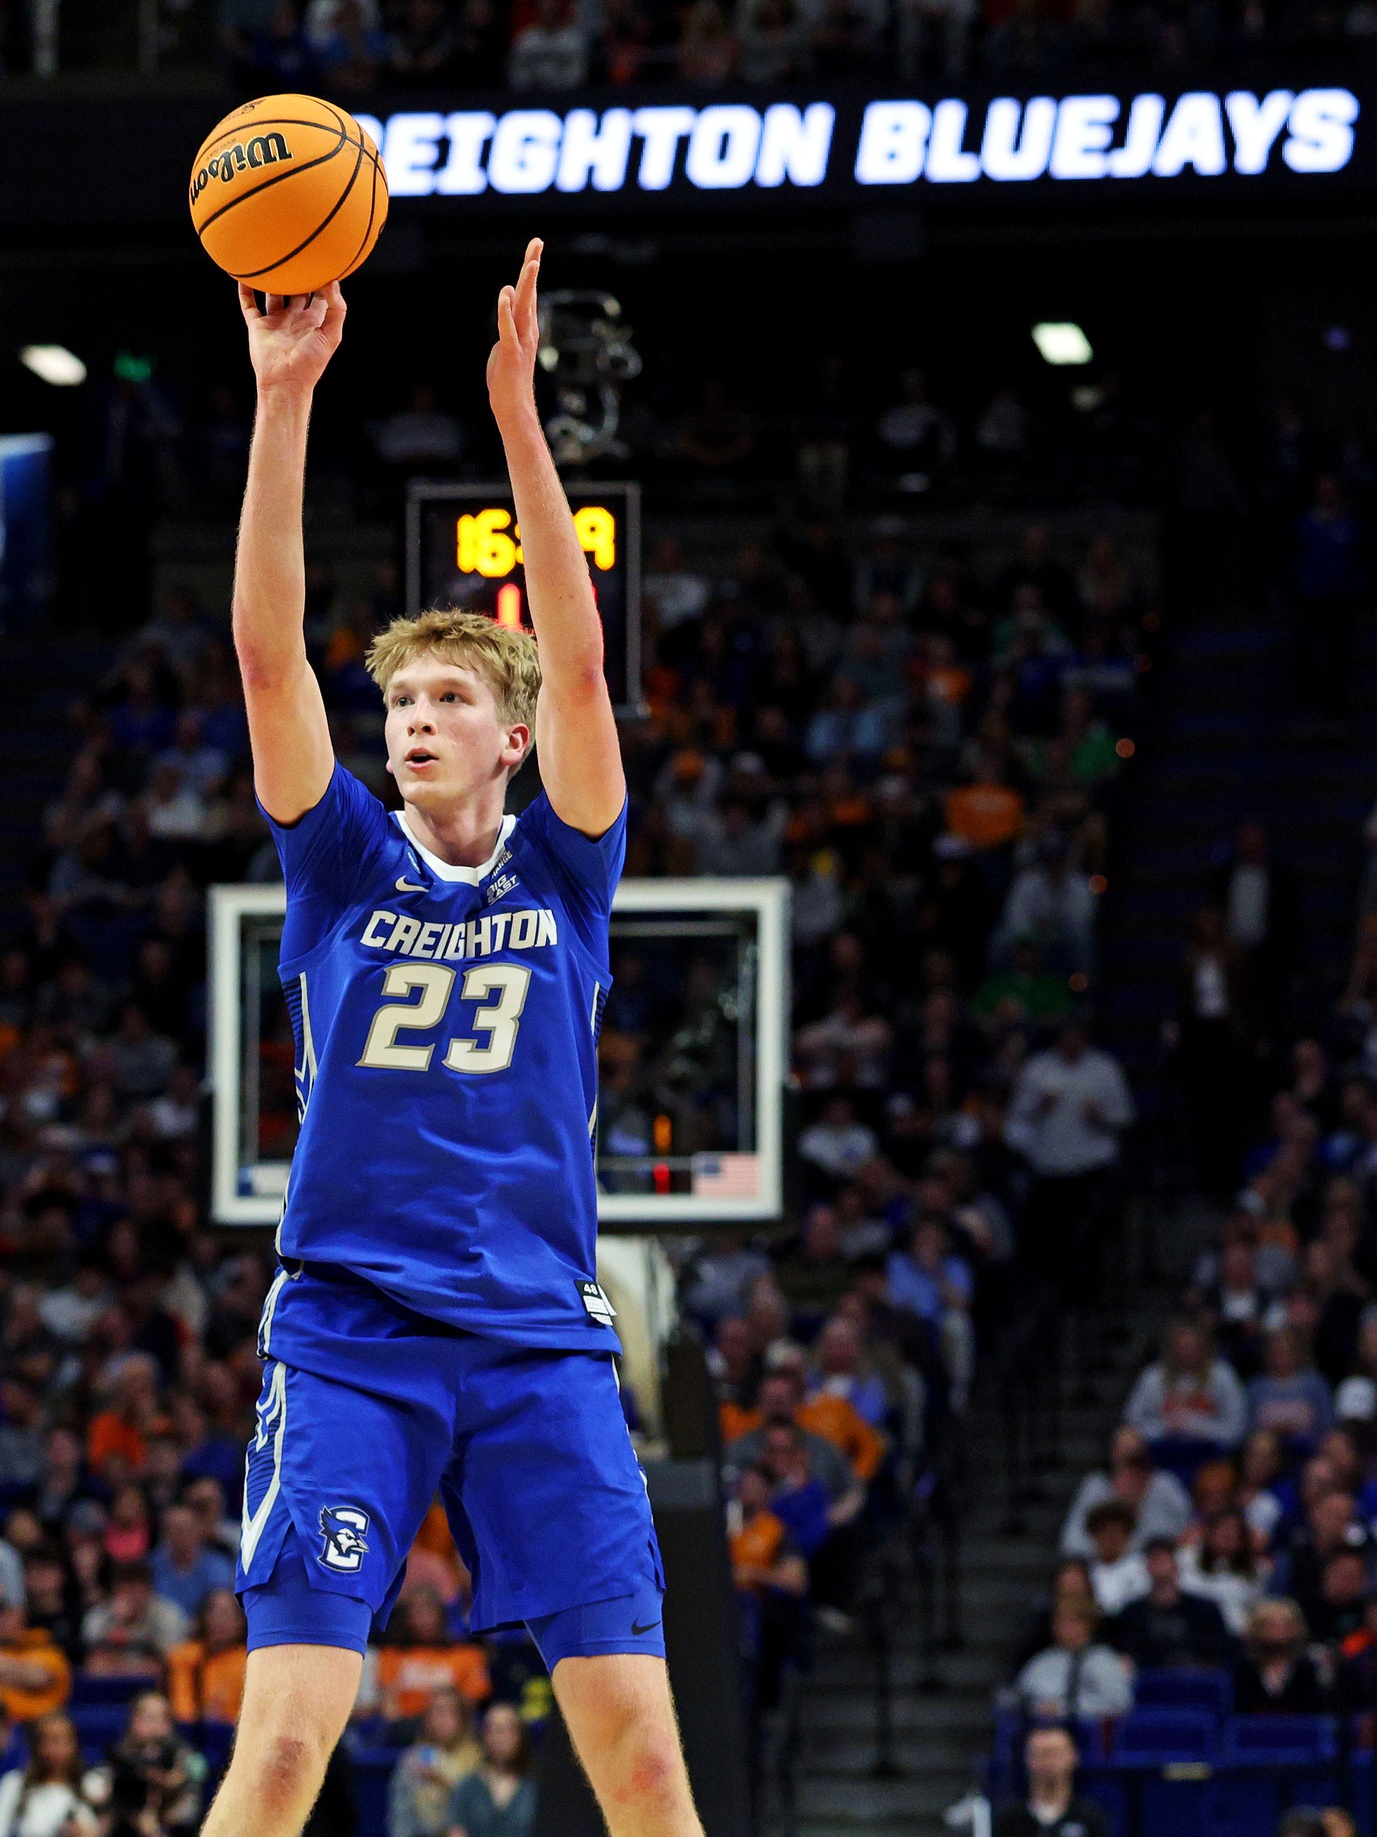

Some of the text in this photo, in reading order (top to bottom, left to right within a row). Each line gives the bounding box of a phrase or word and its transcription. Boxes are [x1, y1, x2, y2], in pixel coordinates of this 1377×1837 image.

[189, 131, 293, 206] Wilson
[350, 88, 1359, 197] EIGHTON BLUEJAYS
[457, 507, 615, 577] 16:9
[360, 909, 558, 961] CREIGHTON
[354, 961, 533, 1075] 23
